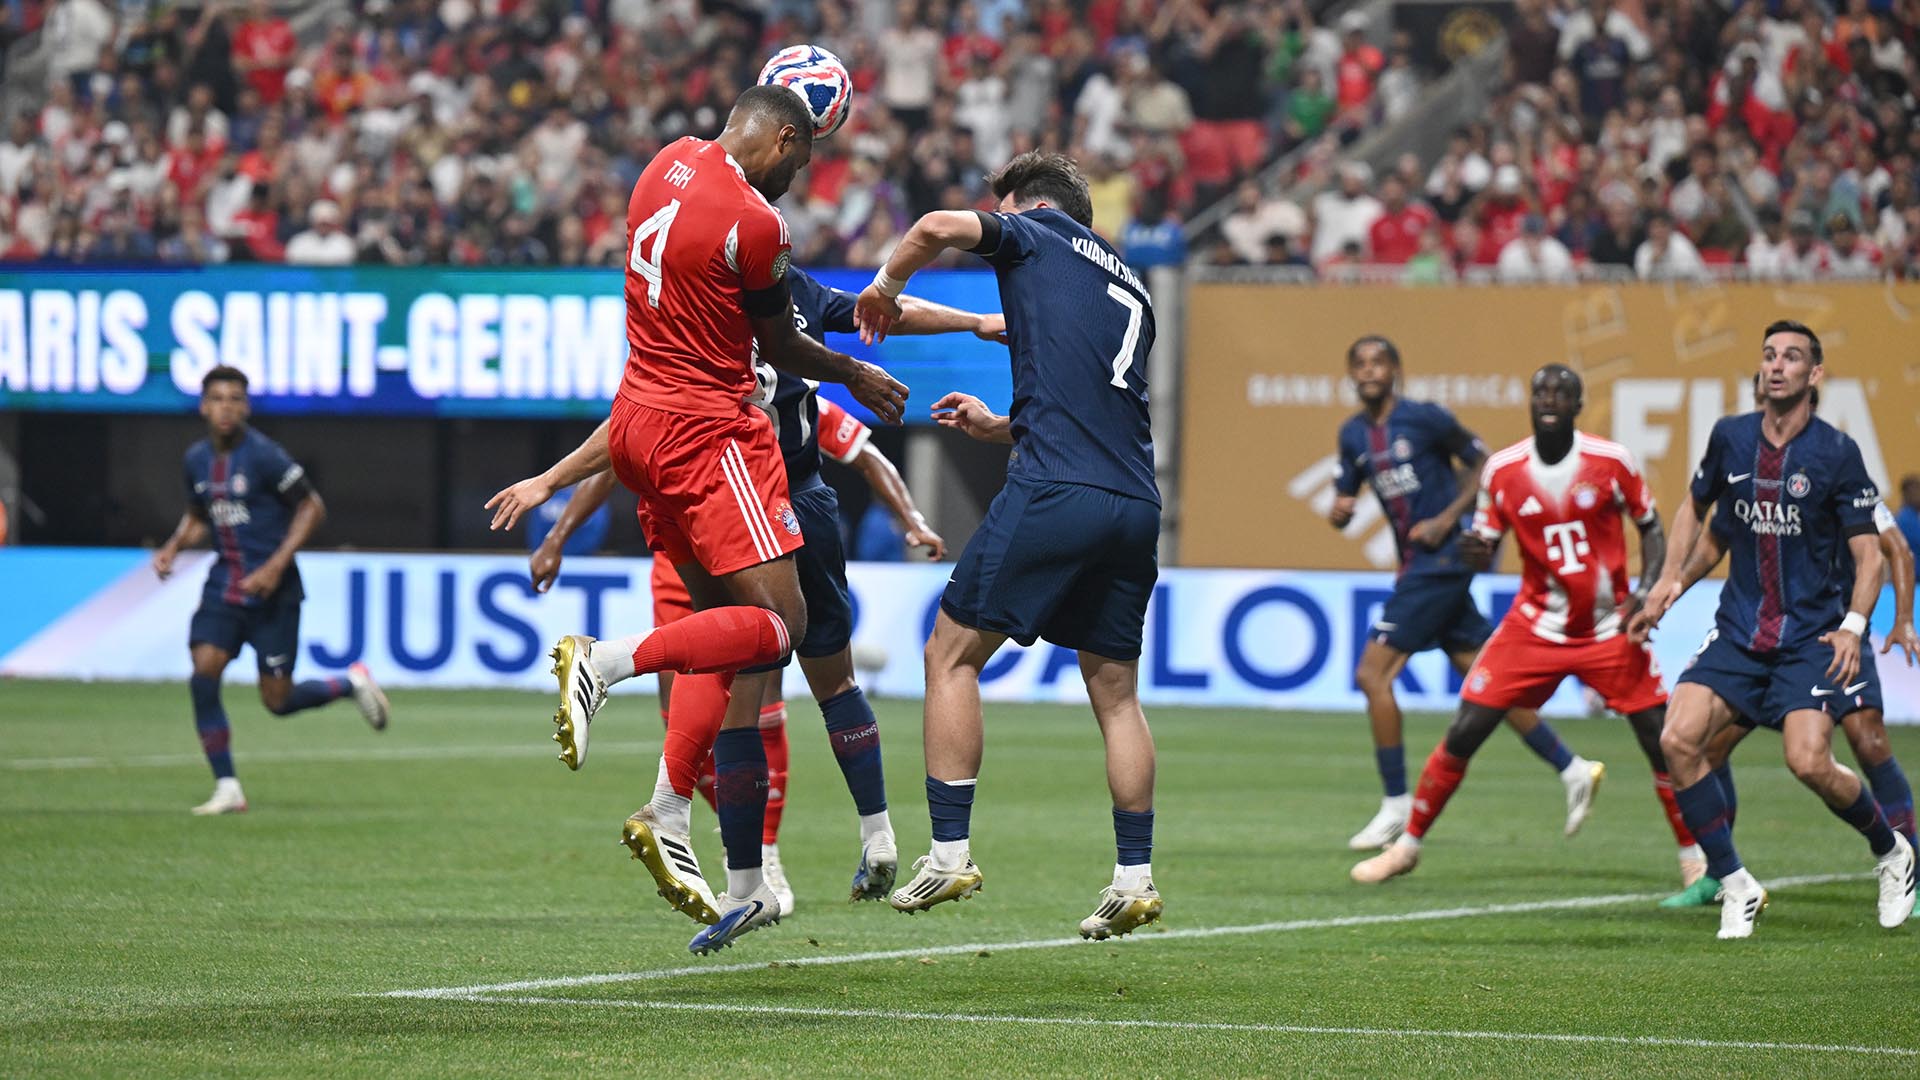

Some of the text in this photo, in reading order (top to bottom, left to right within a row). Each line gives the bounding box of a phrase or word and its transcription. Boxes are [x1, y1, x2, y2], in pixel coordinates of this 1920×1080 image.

[663, 159, 697, 190] TAH
[630, 198, 681, 309] 4
[1107, 282, 1143, 389] 7
[1734, 499, 1801, 524] QATAR
[1750, 520, 1802, 536] AIRWAYS
[1543, 520, 1590, 575] T
[308, 569, 630, 673] JUST
[842, 723, 878, 743] PARIS
